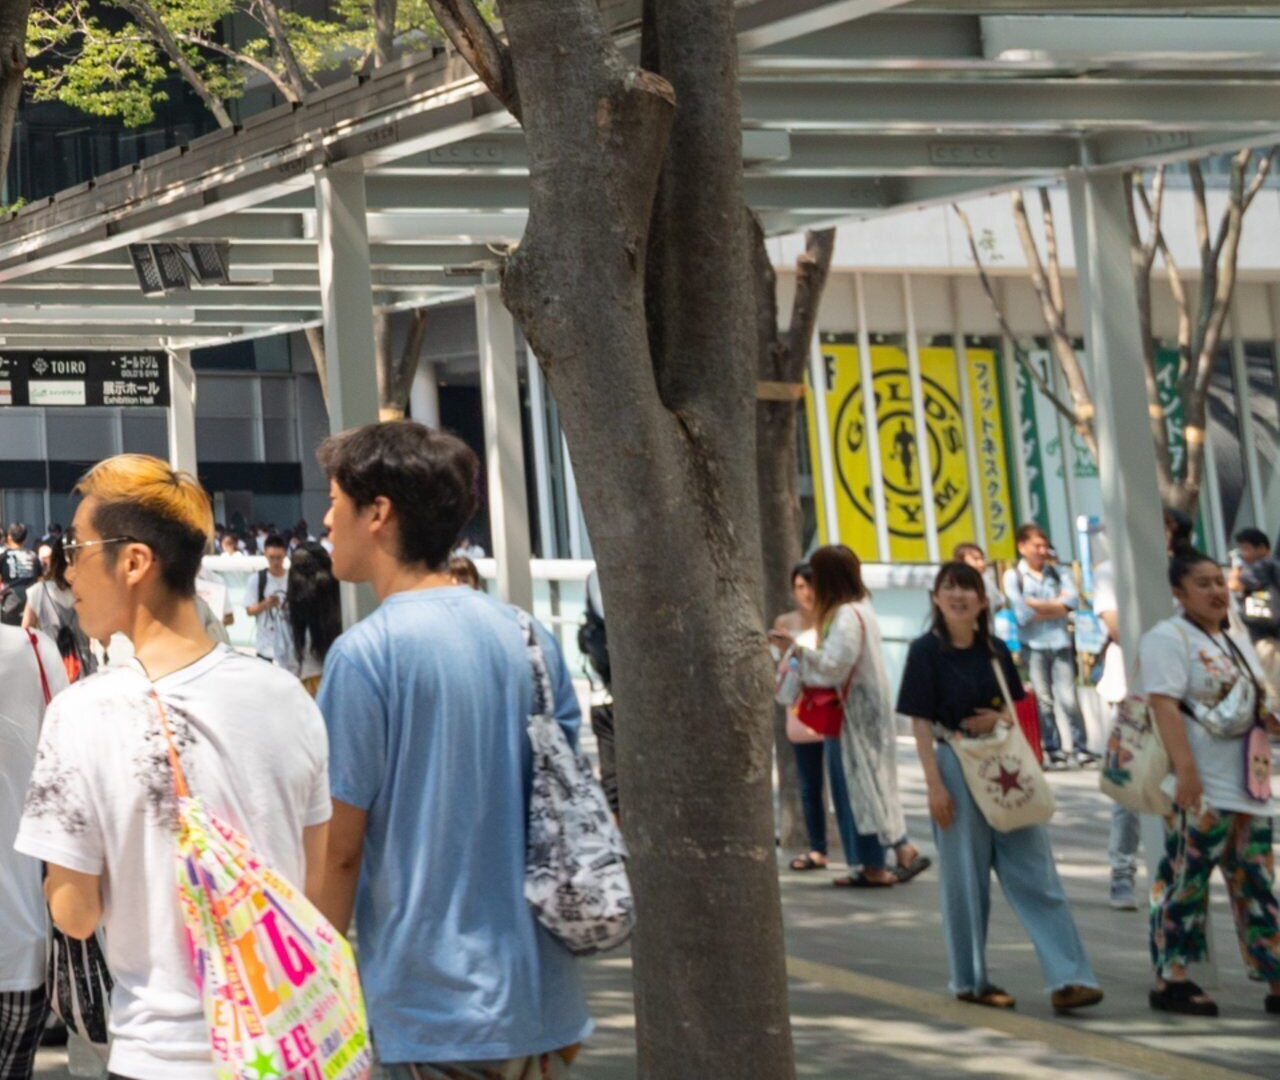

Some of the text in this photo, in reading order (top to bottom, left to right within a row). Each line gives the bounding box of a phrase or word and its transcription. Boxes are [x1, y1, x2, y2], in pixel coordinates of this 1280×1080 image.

[52, 360, 85, 374] TOIRO
[103, 381, 160, 395] 展示ホール
[103, 396, 154, 405] Exhibition Hall
[974, 362, 1007, 542] フィットネスクラブ
